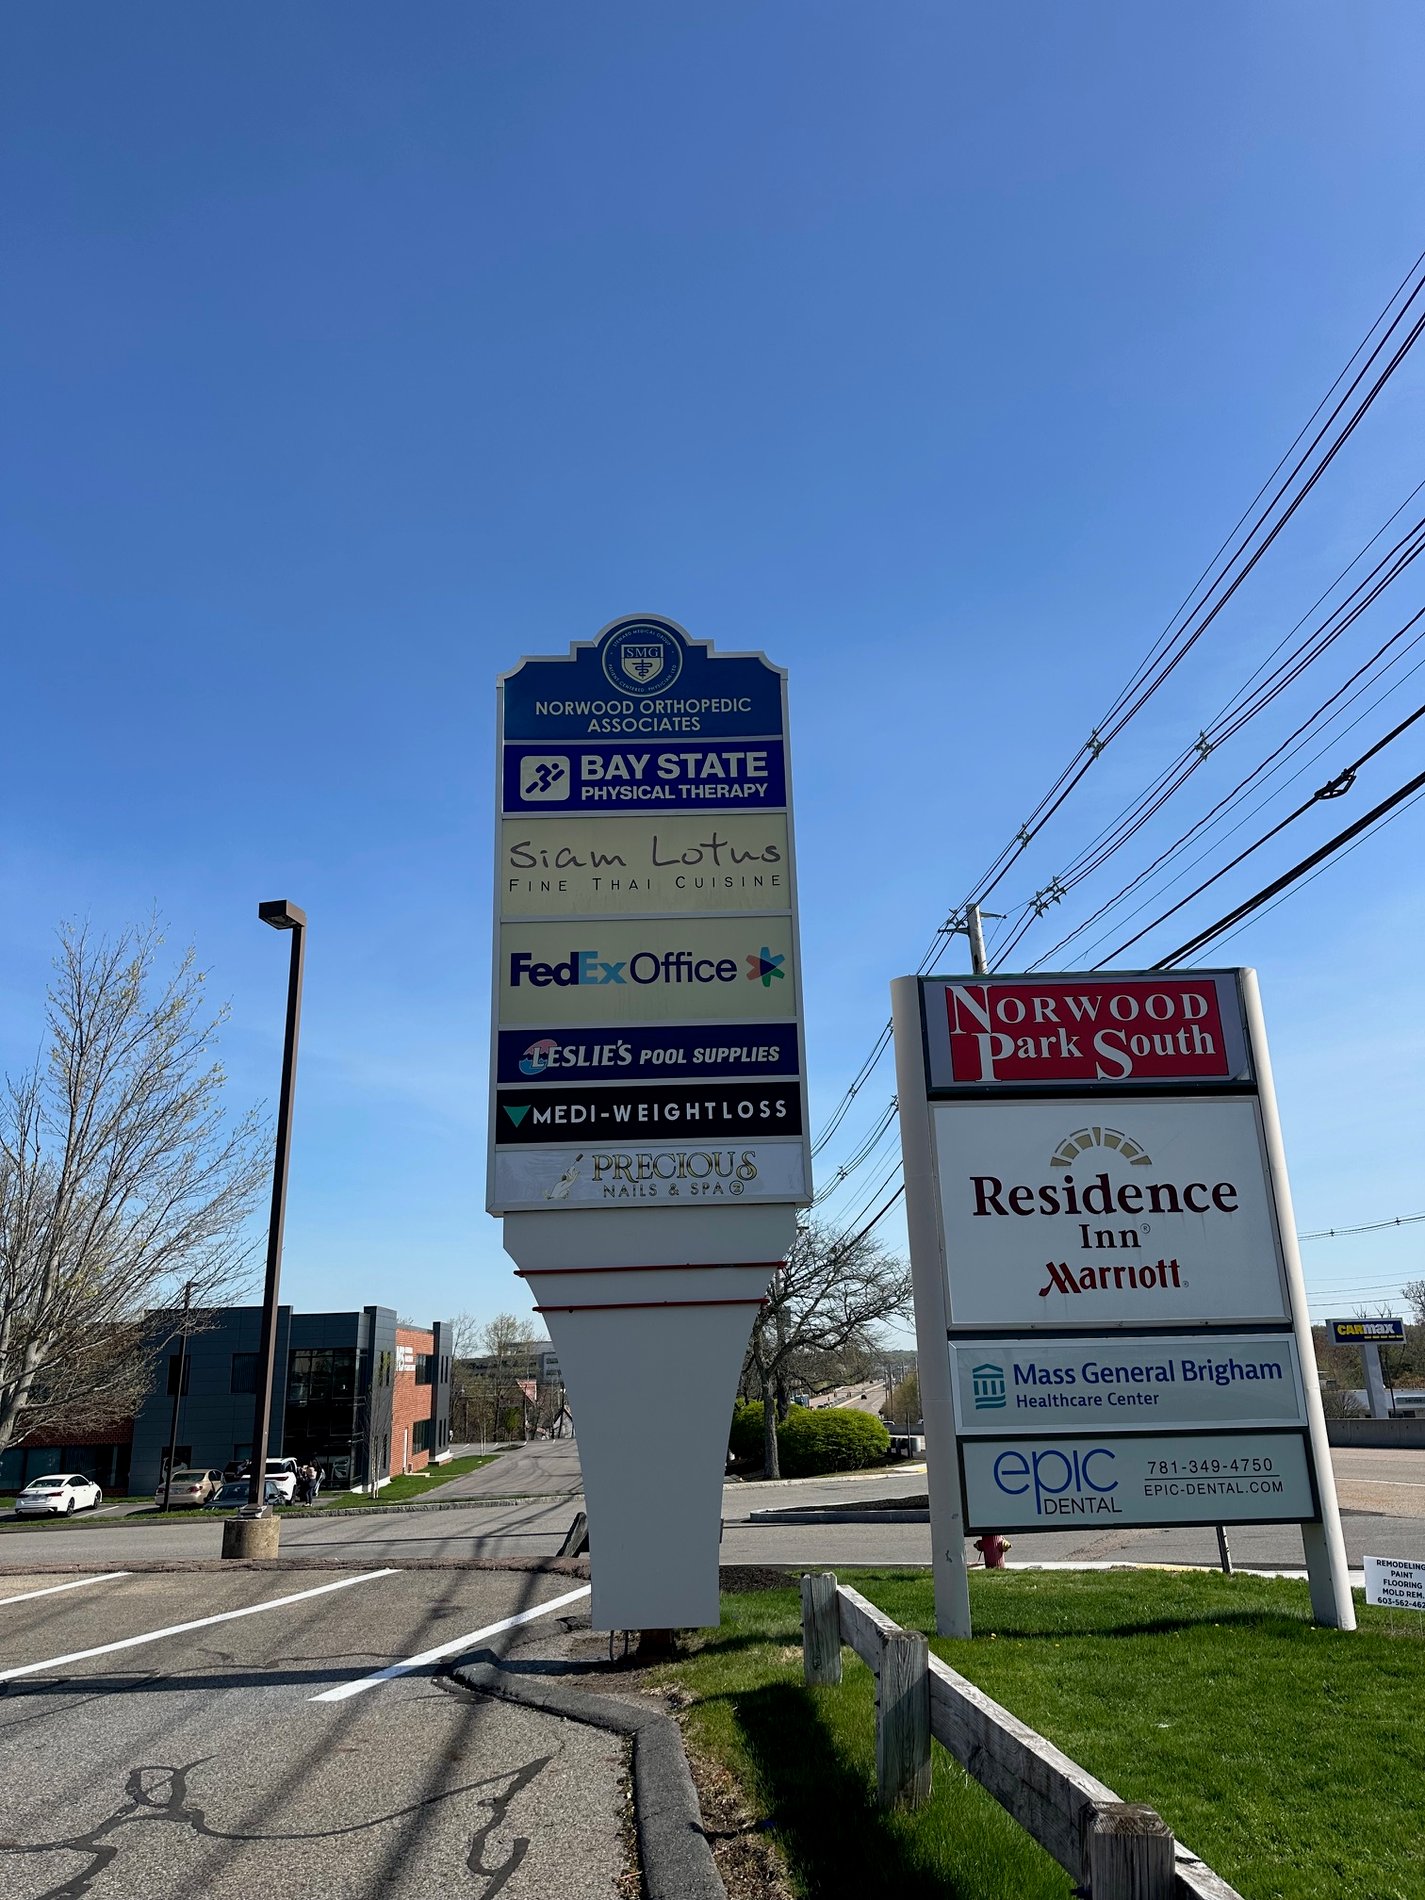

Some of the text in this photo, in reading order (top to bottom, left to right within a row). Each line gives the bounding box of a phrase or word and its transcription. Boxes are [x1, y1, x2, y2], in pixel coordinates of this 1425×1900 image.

[627, 648, 659, 658] SMG
[536, 698, 752, 715] NORWOOD ORTHOPEDIC
[588, 717, 701, 733] ASSOCIATES
[581, 752, 768, 780] BAY STATE
[582, 783, 768, 801] PHYSICAL THERAPY
[510, 832, 781, 869] Siam Lotus
[510, 875, 781, 892] FINE THAI CUISINE
[510, 951, 738, 987] FedEx Office
[946, 984, 1208, 1034] NORWOOD
[532, 1040, 780, 1069] LESLIE'S POOL SUPPLIES
[971, 1025, 1216, 1082] Park South
[533, 1100, 787, 1124] MEDI-WEIGHTLOSS
[592, 1151, 758, 1184] PRECIOUS
[604, 1184, 658, 1198] NAILS
[669, 1183, 680, 1196] &
[691, 1182, 724, 1195] SPA
[969, 1173, 1239, 1217] Residence
[1039, 1259, 1181, 1297] Marriott
[1013, 1359, 1283, 1386] Mass General Brigham
[1017, 1392, 1159, 1408] Healthcare Center
[1148, 1458, 1273, 1474] 781-349-4750
[994, 1449, 1119, 1515] epic
[1144, 1481, 1283, 1496] EPIC-DENTAL.COM
[1044, 1497, 1123, 1515] DENTAL
[1377, 1560, 1425, 1571] REMODELING
[1383, 1579, 1423, 1589] FLOORING
[1391, 1571, 1413, 1579] PAINT
[1383, 1588, 1405, 1597] MOLD
